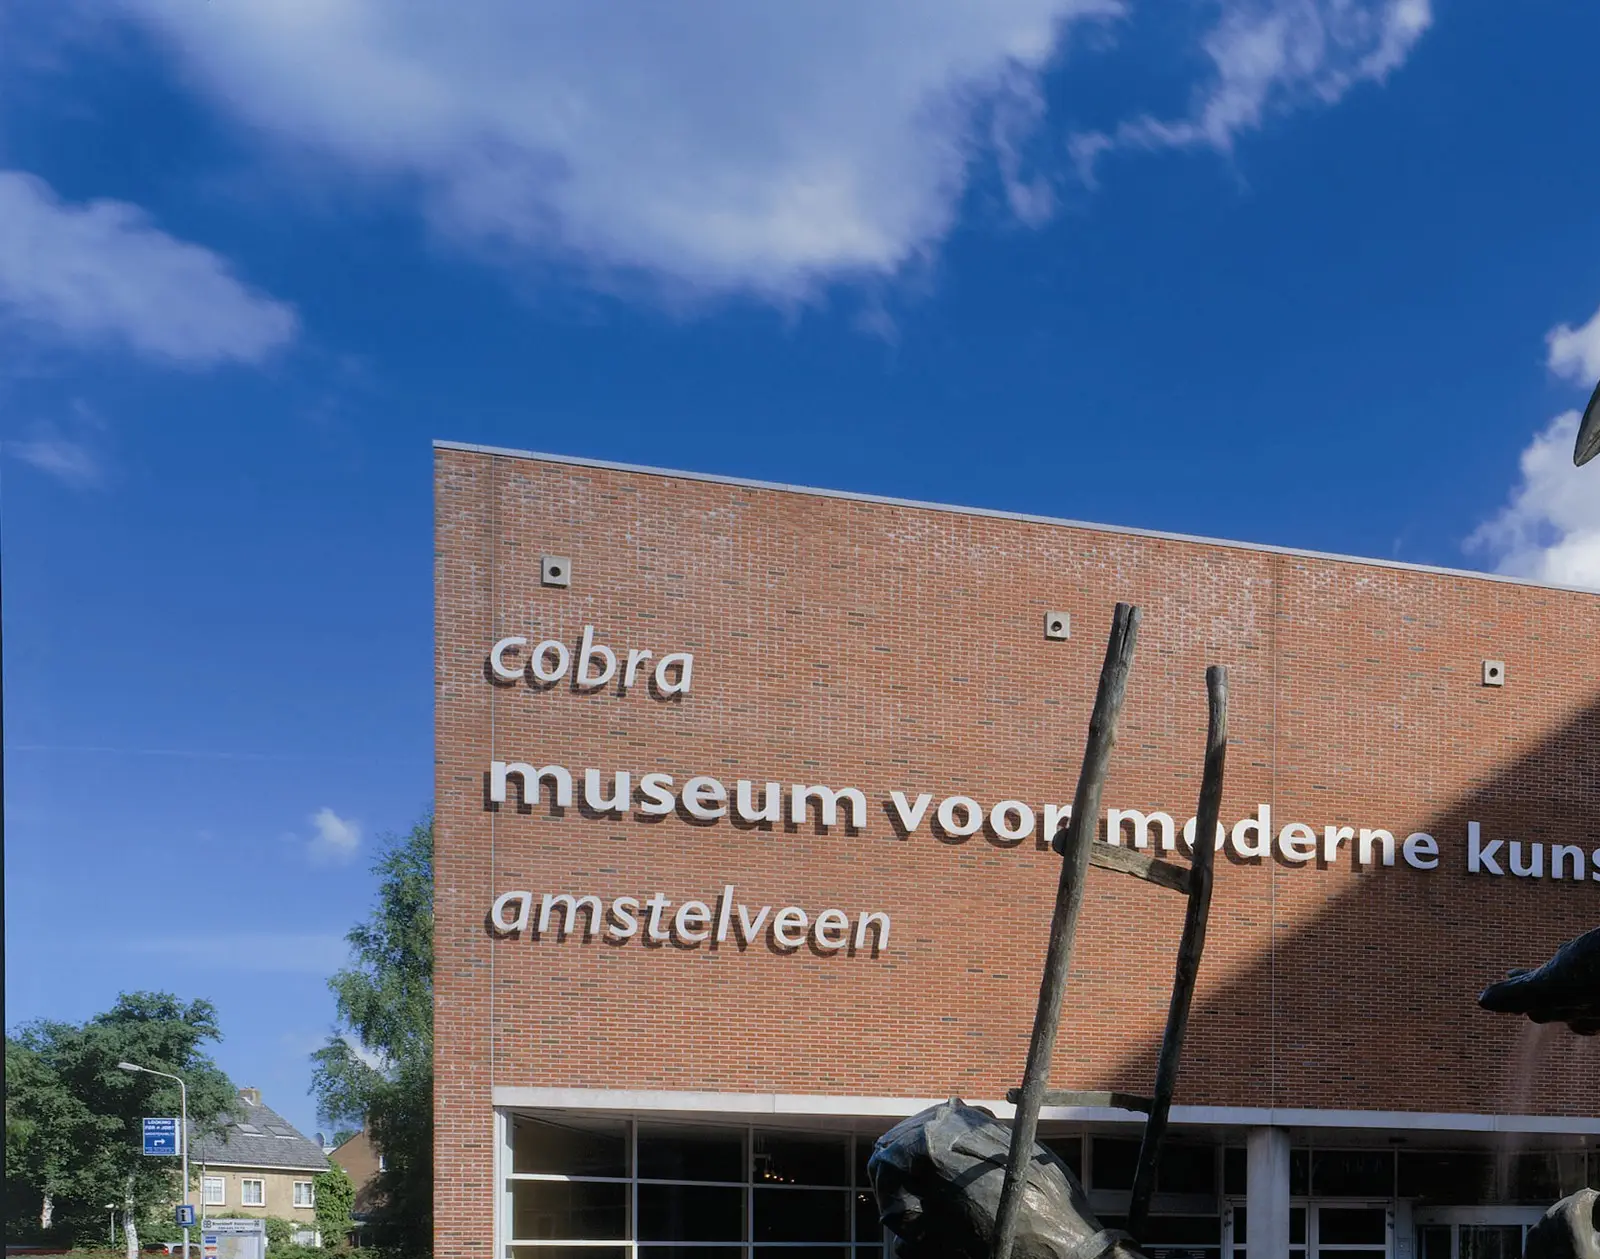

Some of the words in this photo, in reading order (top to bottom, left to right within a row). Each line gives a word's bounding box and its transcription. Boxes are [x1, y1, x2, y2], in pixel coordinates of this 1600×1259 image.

[489, 624, 694, 695] cobra
[489, 760, 867, 829] museum
[890, 790, 1073, 843] voor
[1106, 803, 1440, 869] moderne
[490, 884, 892, 951] amstelveen
